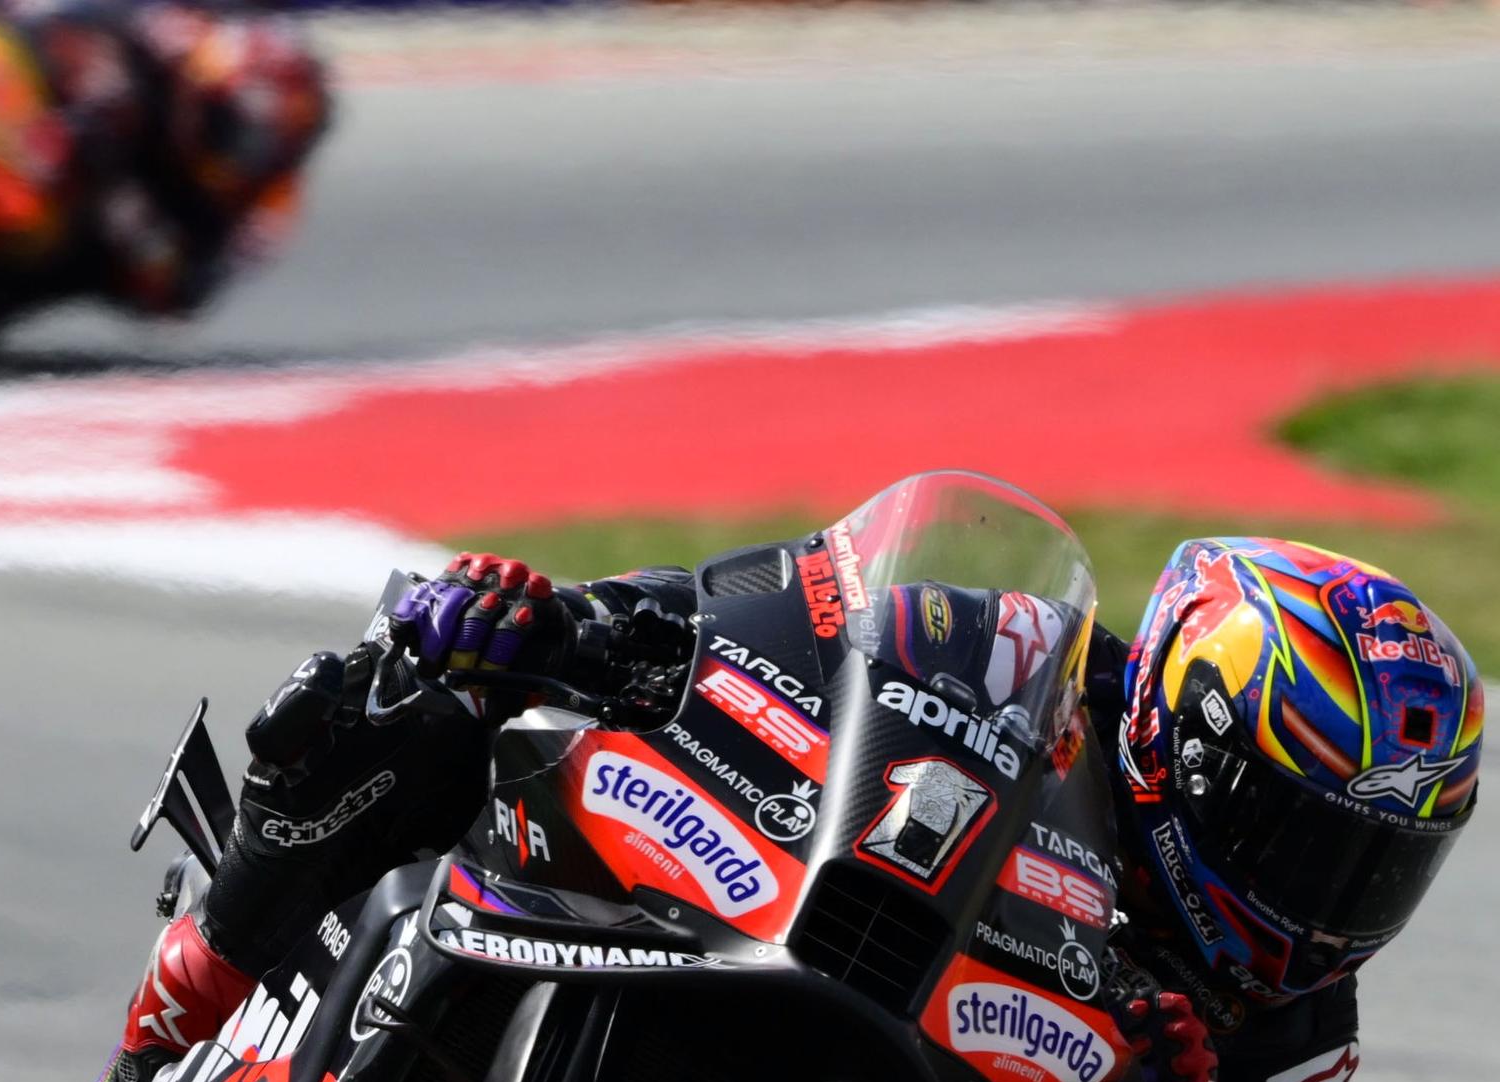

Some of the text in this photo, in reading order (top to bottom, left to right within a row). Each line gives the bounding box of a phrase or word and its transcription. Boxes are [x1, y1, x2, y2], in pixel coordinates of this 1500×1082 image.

[708, 635, 823, 717] TARGA
[702, 669, 820, 755] BS
[877, 681, 1021, 781] aprilia
[1205, 698, 1226, 729] 100%
[664, 722, 765, 803] PRAGMATIC
[262, 770, 396, 848] alpinestars
[591, 764, 761, 903] sterilgarda
[763, 800, 808, 835] PLAY
[855, 757, 997, 894] 1
[1325, 792, 1452, 832] GIVES YOU WINGS
[623, 829, 685, 881] alimenti
[1016, 853, 1104, 918] BS
[1031, 822, 1117, 889] TARGA
[1247, 890, 1305, 935] Breathe Right
[976, 921, 1057, 971] PRAGMATIC
[1062, 959, 1096, 986] PLAY
